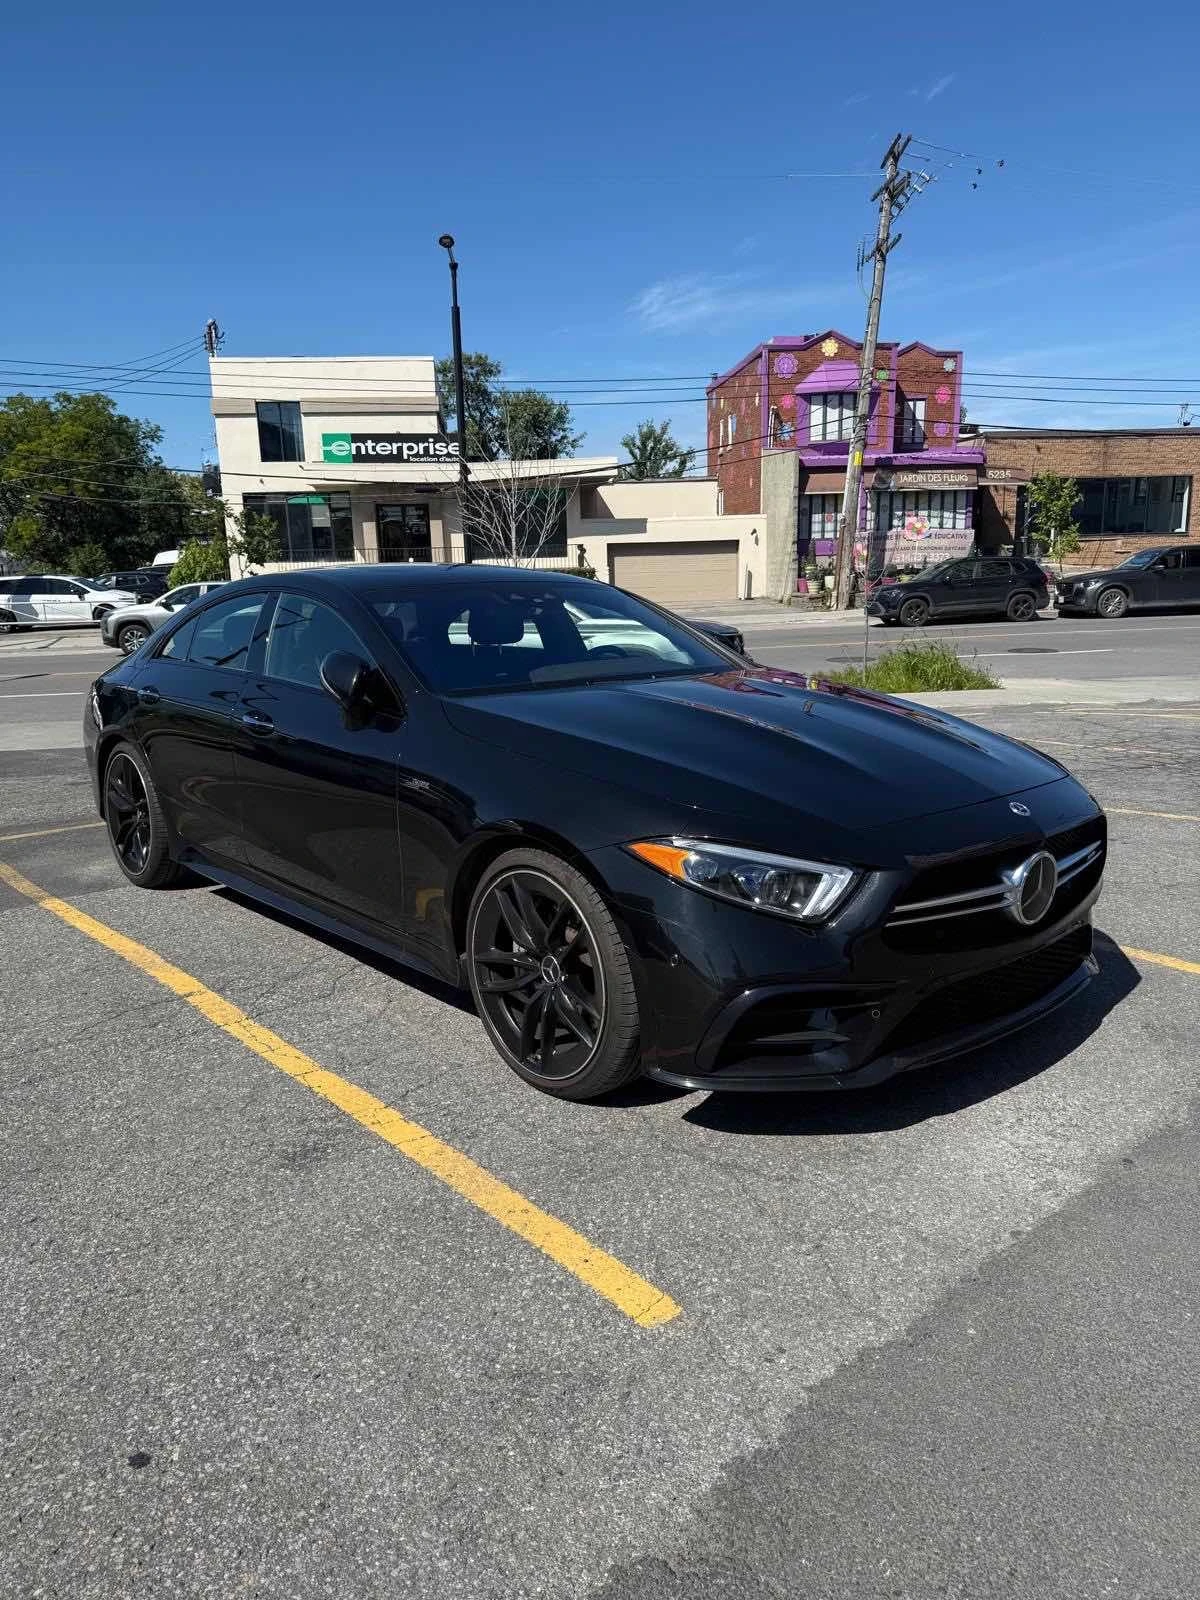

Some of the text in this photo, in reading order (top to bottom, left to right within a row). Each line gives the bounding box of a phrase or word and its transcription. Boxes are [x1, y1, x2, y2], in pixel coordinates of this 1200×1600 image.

[322, 438, 459, 459] enterprise
[900, 473, 968, 483] JARDIN DES FLEURS
[988, 470, 1011, 479] 5235
